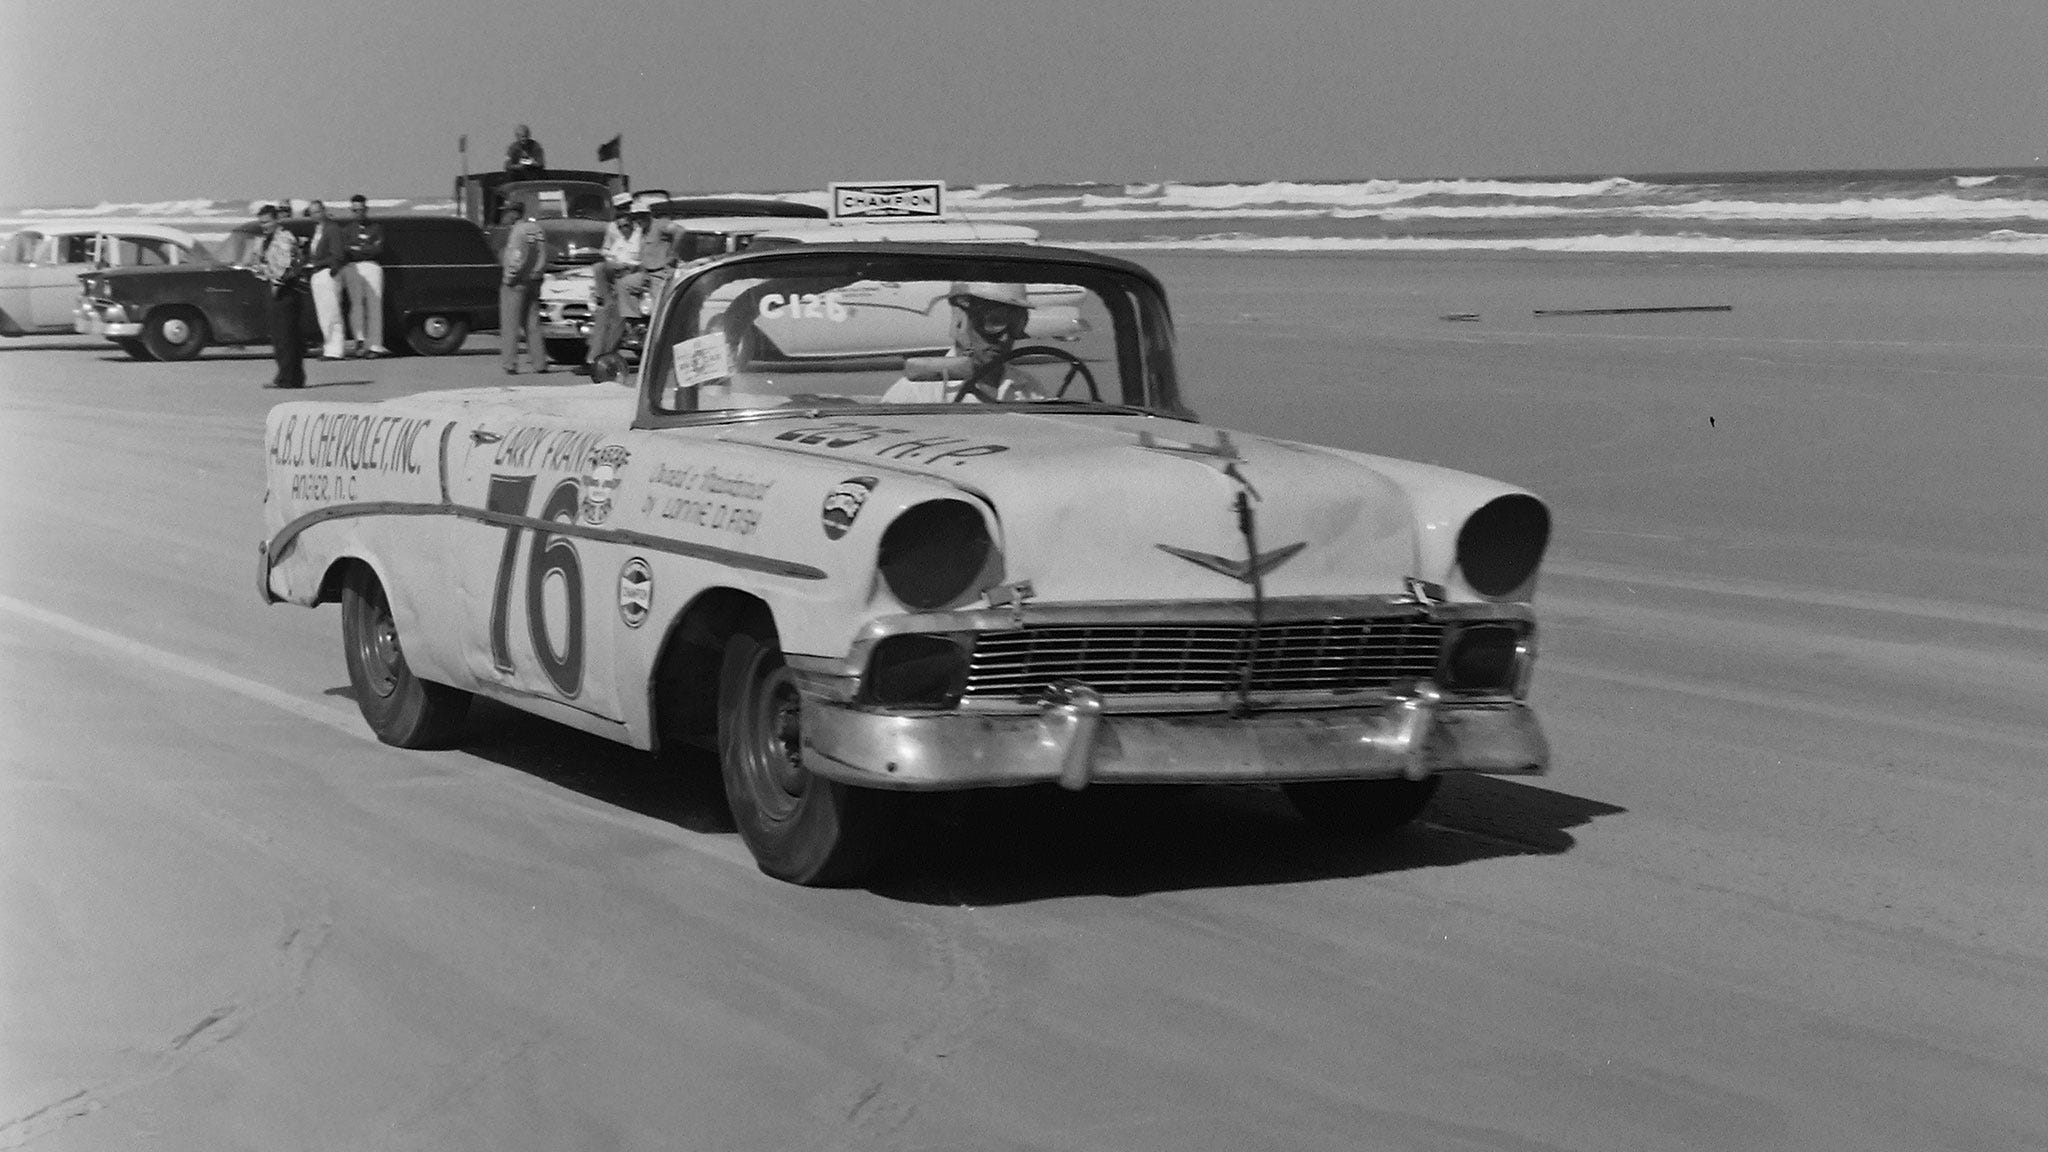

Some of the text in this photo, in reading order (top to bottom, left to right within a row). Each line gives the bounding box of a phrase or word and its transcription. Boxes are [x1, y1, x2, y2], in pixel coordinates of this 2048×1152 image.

[844, 195, 931, 207] CHAMPION
[494, 426, 552, 468] LARRY
[486, 473, 586, 700] 76
